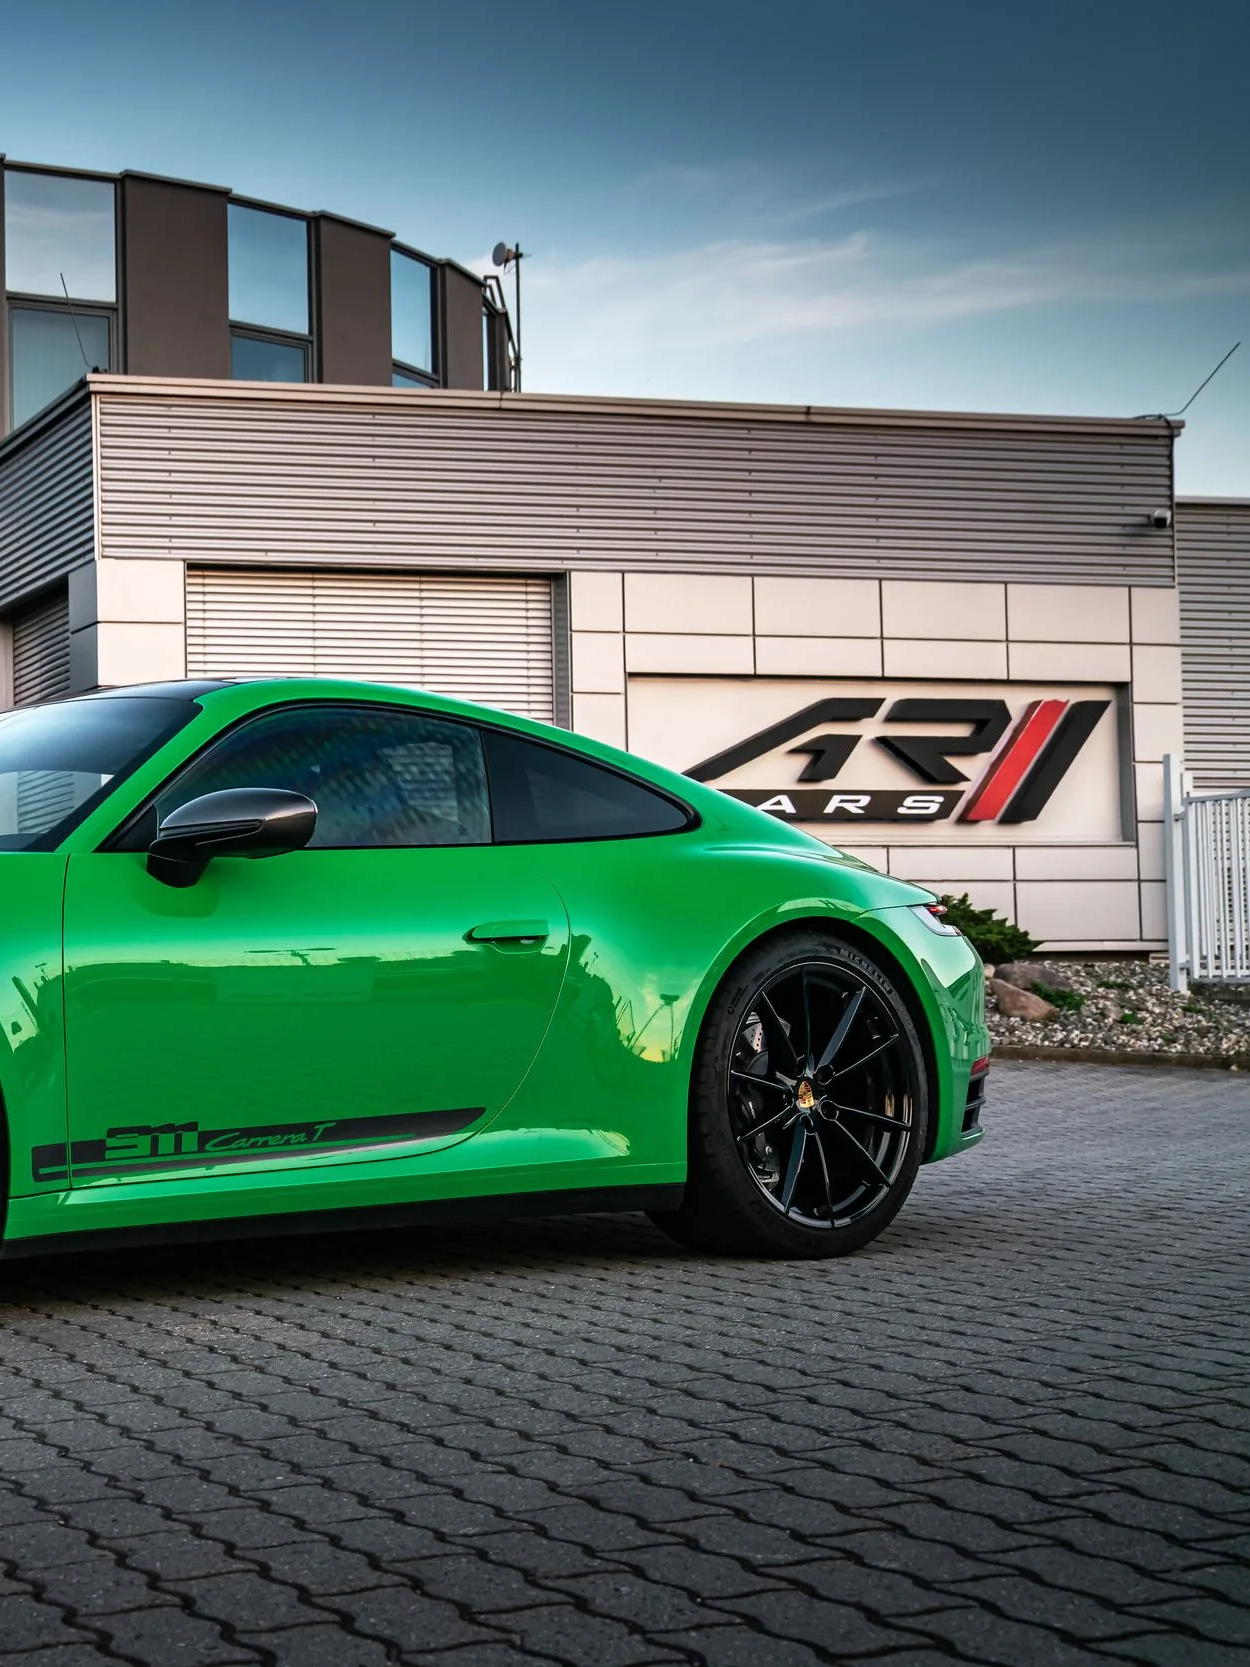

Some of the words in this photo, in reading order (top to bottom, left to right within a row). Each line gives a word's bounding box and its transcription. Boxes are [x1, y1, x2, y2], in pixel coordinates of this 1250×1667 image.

[755, 794, 945, 815] ARS
[105, 1122, 198, 1159] 911
[205, 1132, 306, 1151] Carrera
[310, 1122, 336, 1143] T
